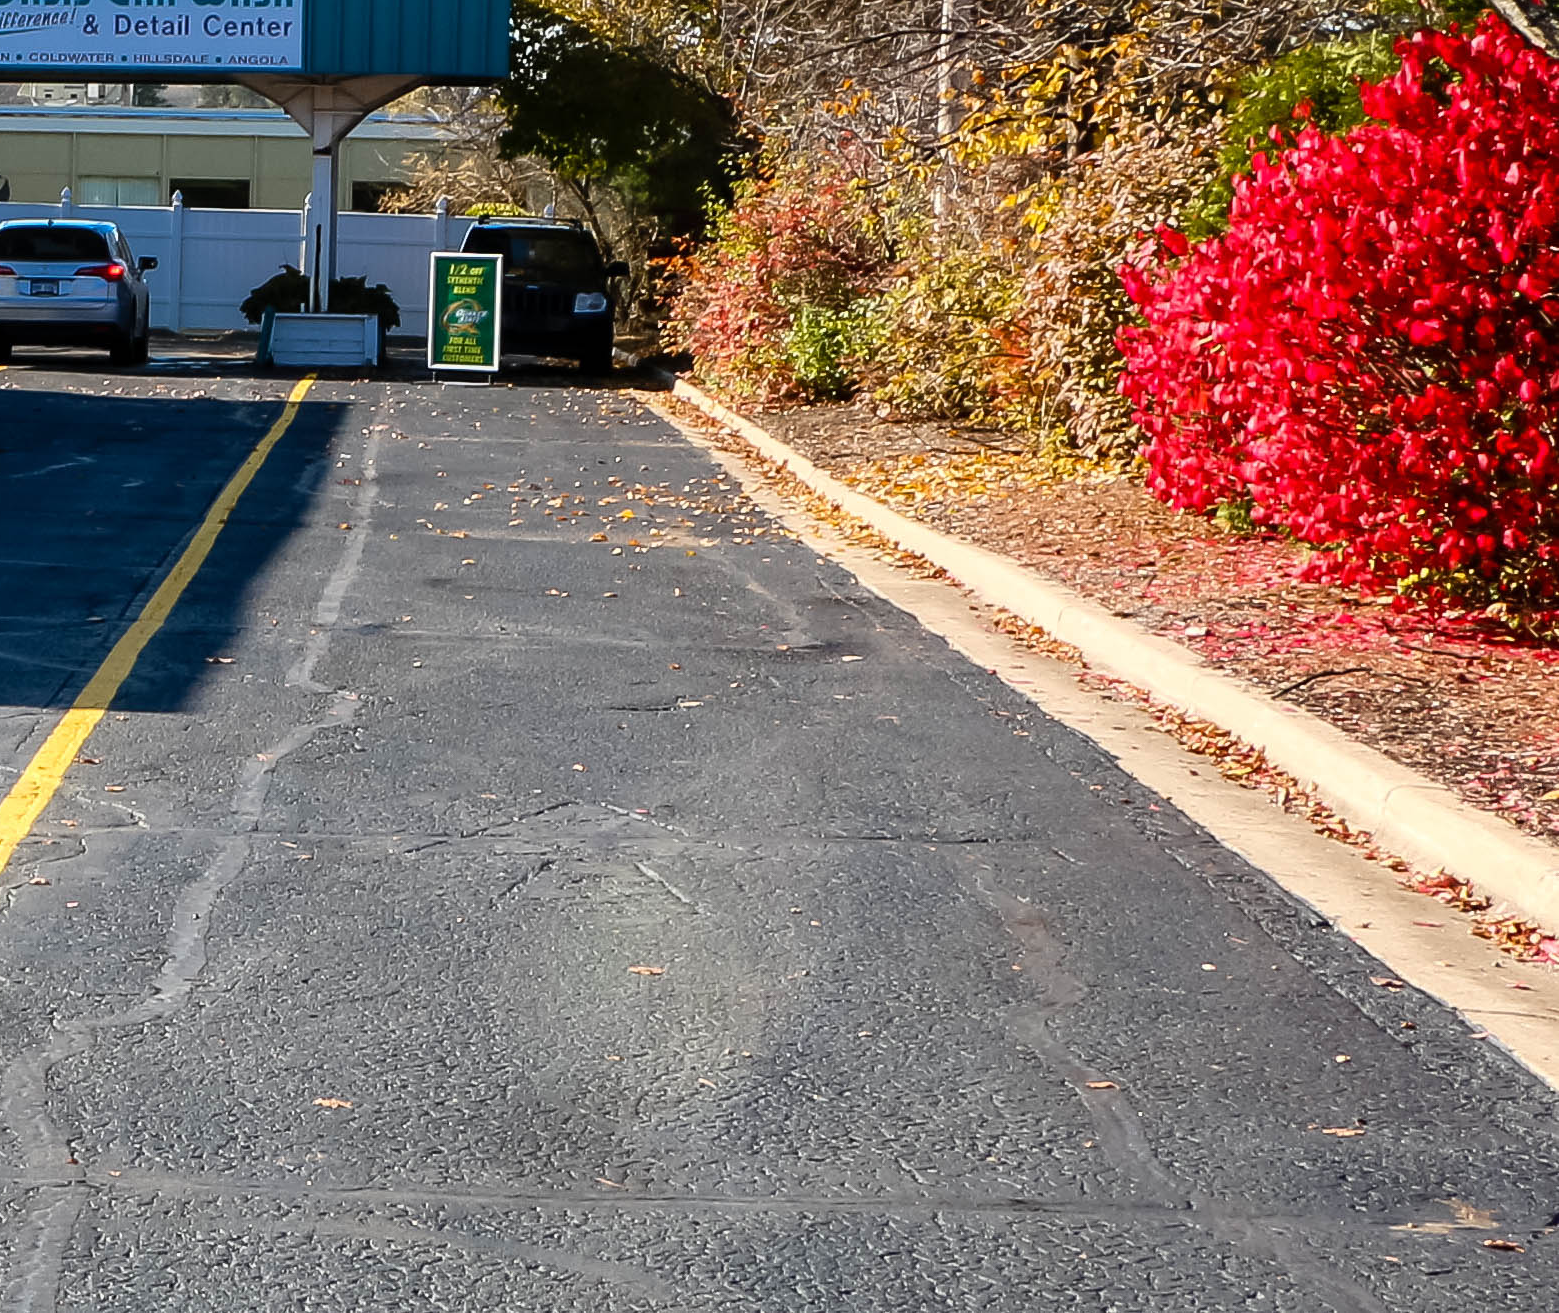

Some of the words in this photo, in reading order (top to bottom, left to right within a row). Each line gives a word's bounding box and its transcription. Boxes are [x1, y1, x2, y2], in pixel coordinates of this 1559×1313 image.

[82, 14, 99, 35] &
[114, 14, 190, 36] Detail
[203, 14, 293, 37] Center
[28, 51, 115, 63] COLDWATER
[133, 53, 209, 64] HILLSDALE
[227, 54, 289, 65] ANGOLA
[449, 263, 468, 275] 1/2
[449, 337, 464, 345] FOR
[464, 337, 477, 345] ALL
